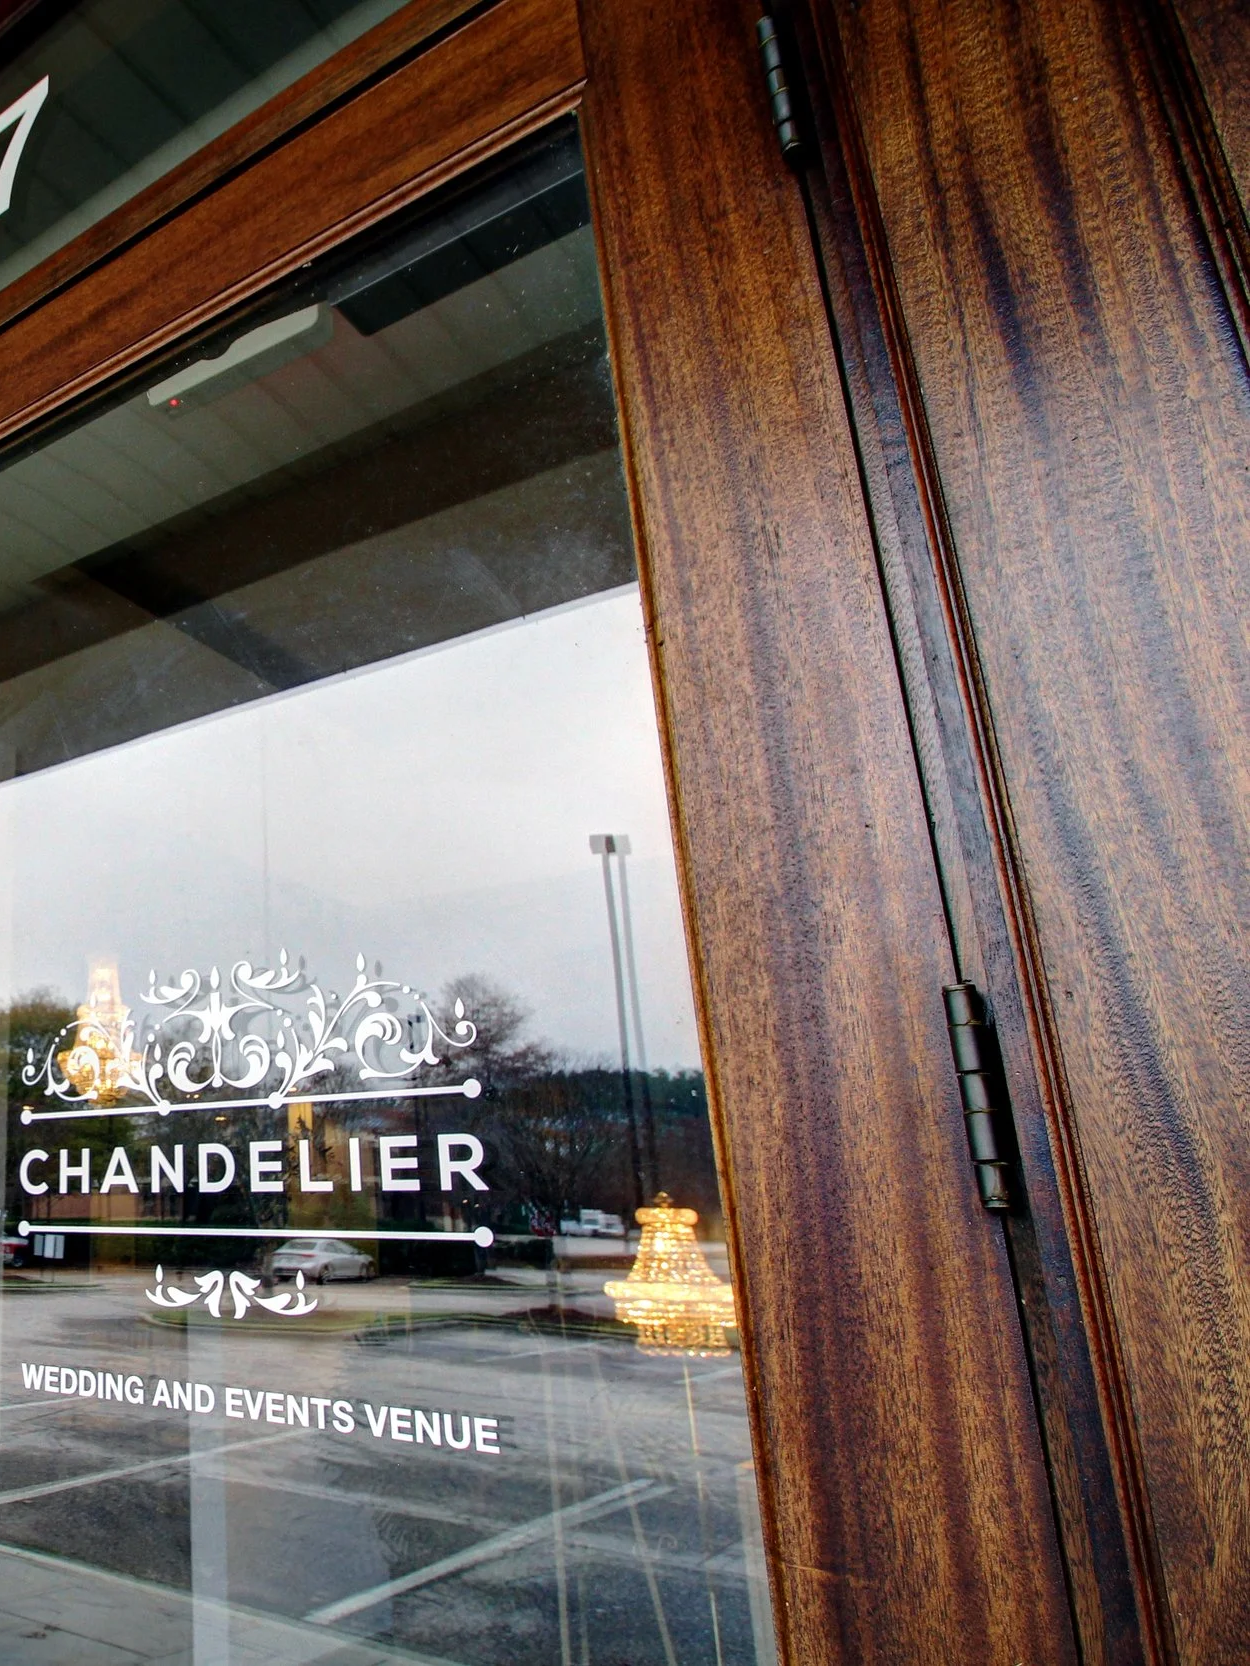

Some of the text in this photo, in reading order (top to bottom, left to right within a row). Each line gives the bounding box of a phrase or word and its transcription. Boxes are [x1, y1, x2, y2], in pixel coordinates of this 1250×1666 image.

[19, 1133, 489, 1195] CHANDELIER
[21, 1363, 500, 1454] WEDDING AND EVENTS VENUE
